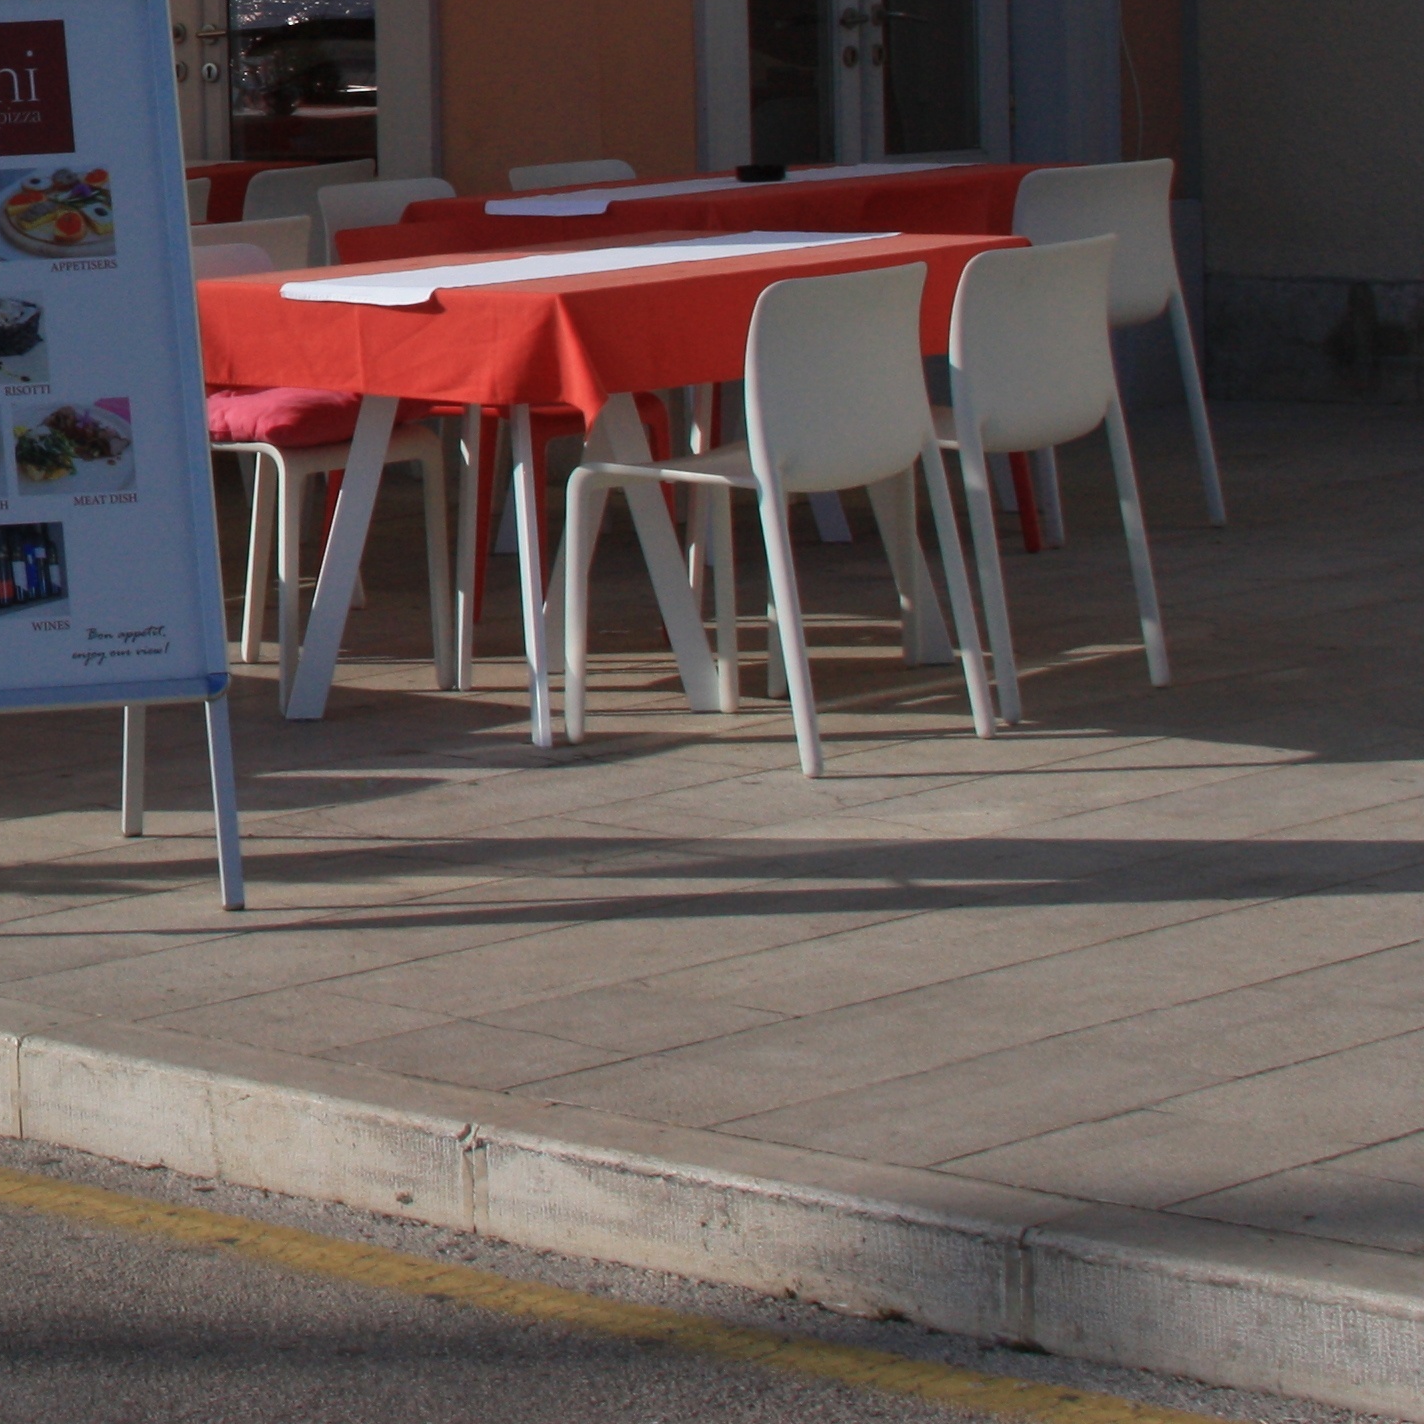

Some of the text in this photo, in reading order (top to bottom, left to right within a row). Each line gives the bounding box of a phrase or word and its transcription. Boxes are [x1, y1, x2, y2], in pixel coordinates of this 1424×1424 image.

[50, 258, 118, 273] APPETISERS
[4, 384, 51, 396] RISOTTI
[73, 492, 138, 507] MEAT DISH
[31, 619, 71, 632] WINES
[86, 627, 114, 641] Bon
